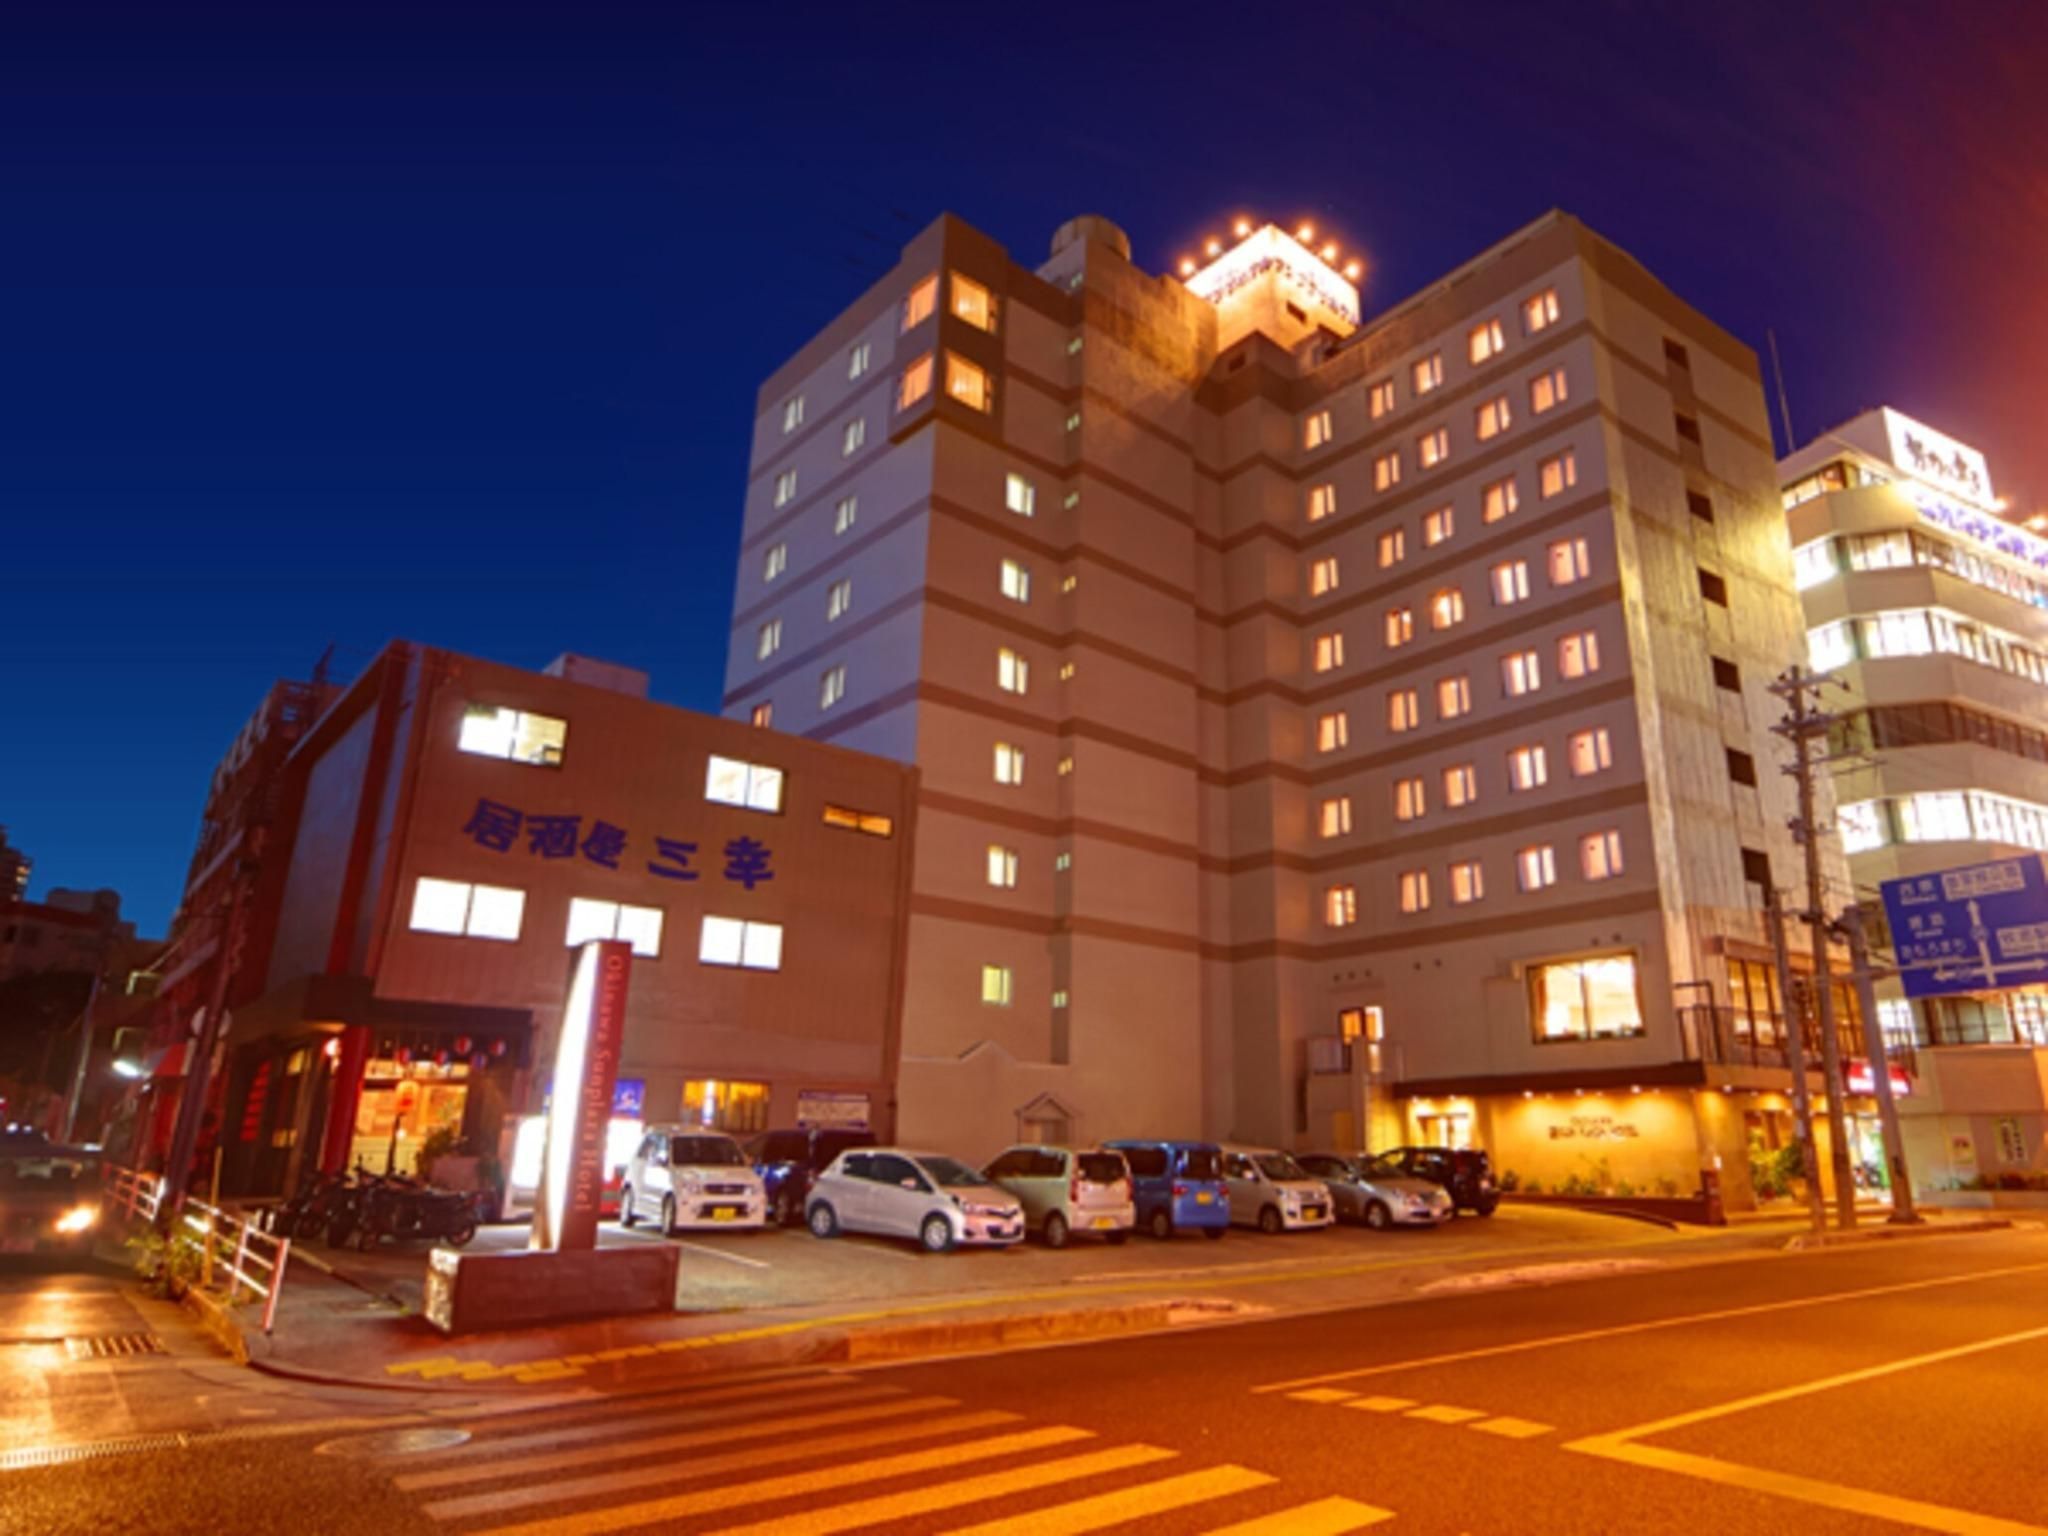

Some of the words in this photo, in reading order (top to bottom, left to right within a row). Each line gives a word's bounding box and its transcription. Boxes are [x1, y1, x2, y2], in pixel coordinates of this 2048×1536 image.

[464, 799, 627, 869] 居酒屋
[599, 955, 623, 1041] Okinawa
[584, 1049, 611, 1141] Sunplaza
[575, 1149, 599, 1212] Hotel
